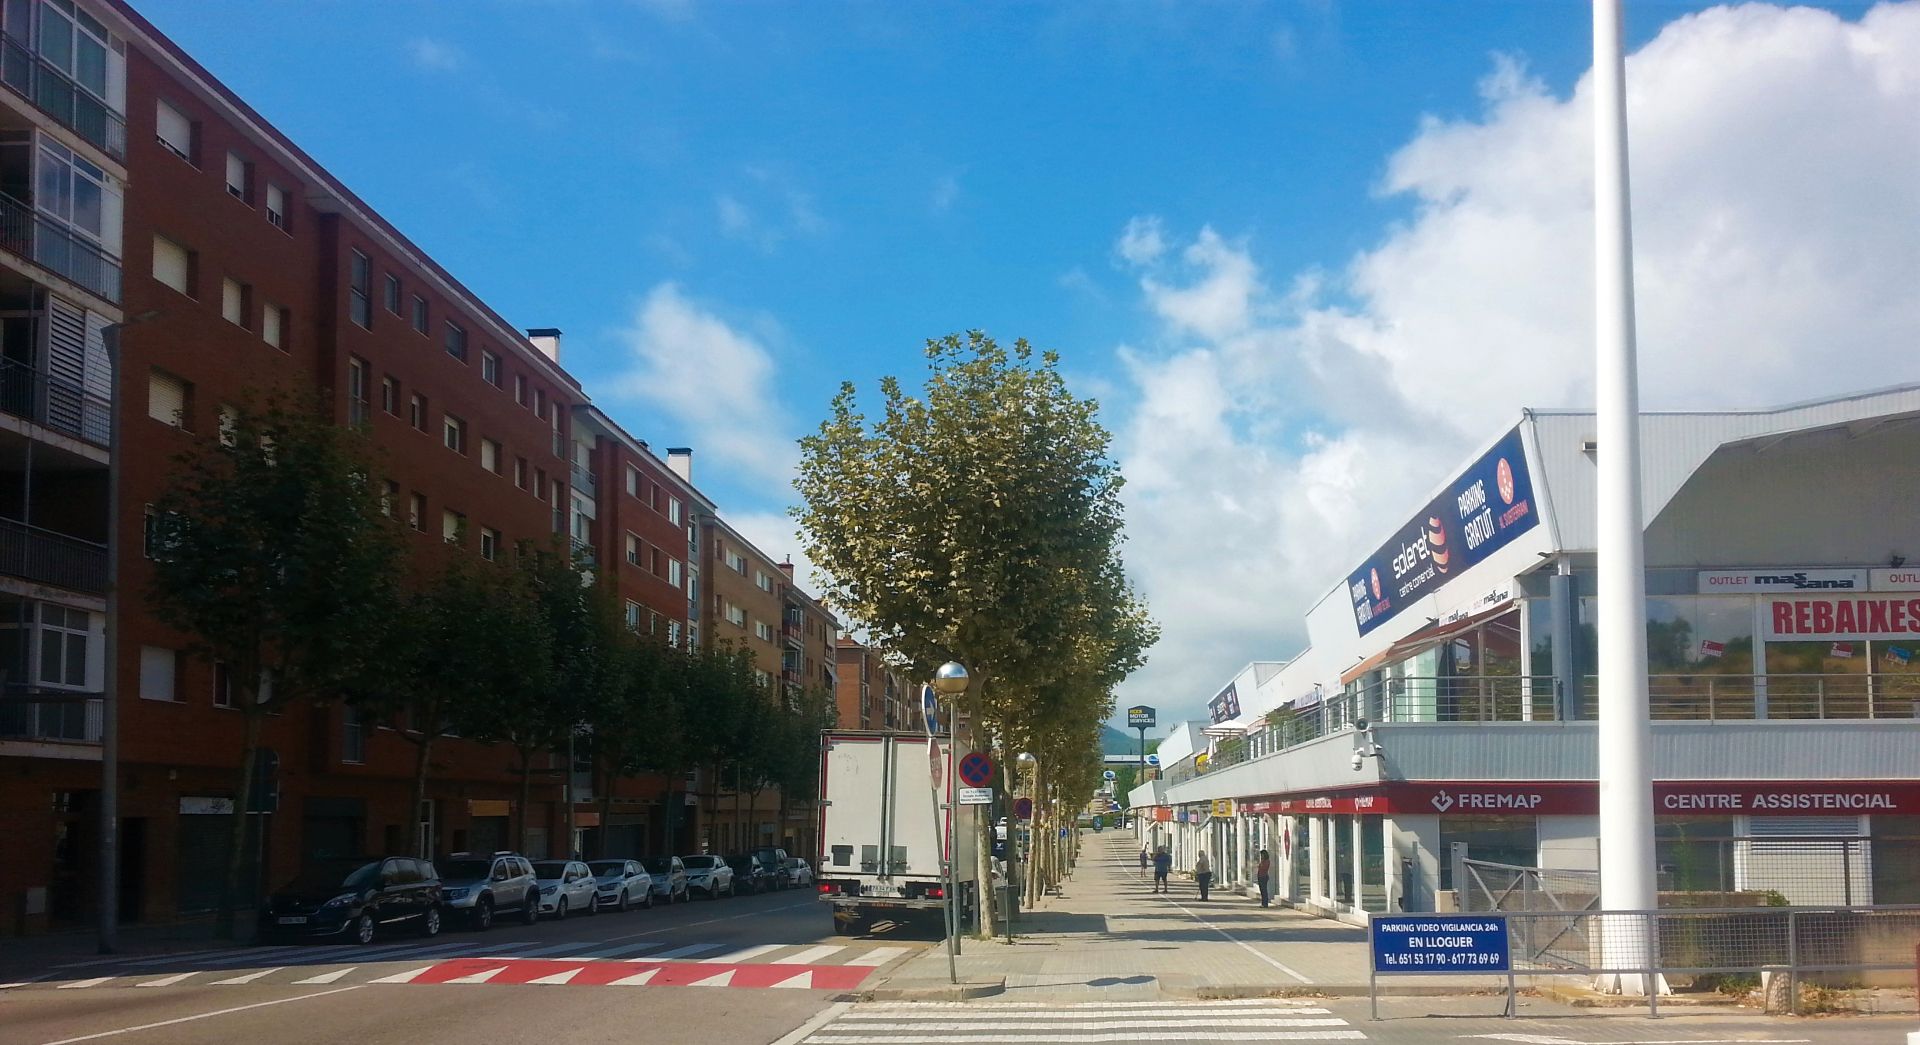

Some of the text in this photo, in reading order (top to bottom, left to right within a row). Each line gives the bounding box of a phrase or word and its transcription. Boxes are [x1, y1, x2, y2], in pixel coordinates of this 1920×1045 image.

[1458, 479, 1486, 519] PARKING
[1392, 526, 1431, 580] soleret
[1398, 563, 1436, 598] centre comercial
[1709, 576, 1749, 585] OUTLET
[1772, 599, 1920, 635] REBAIXES
[1458, 794, 1542, 809] FREMAP
[1664, 793, 1897, 809] CENTRE ASSISTENCIAL
[1382, 923, 1499, 932] PARKING VIDEO VIGILANCIA 24h
[1409, 937, 1474, 948] EN LLOGUER
[1384, 954, 1397, 964] Tel.
[1398, 954, 1412, 965] 651
[1414, 954, 1424, 964] 53
[1425, 954, 1434, 964] 17
[1435, 954, 1446, 964] 90
[1451, 954, 1466, 964] 617
[1467, 954, 1477, 964] 73
[1478, 953, 1488, 964] 69
[1489, 953, 1499, 964] 69
